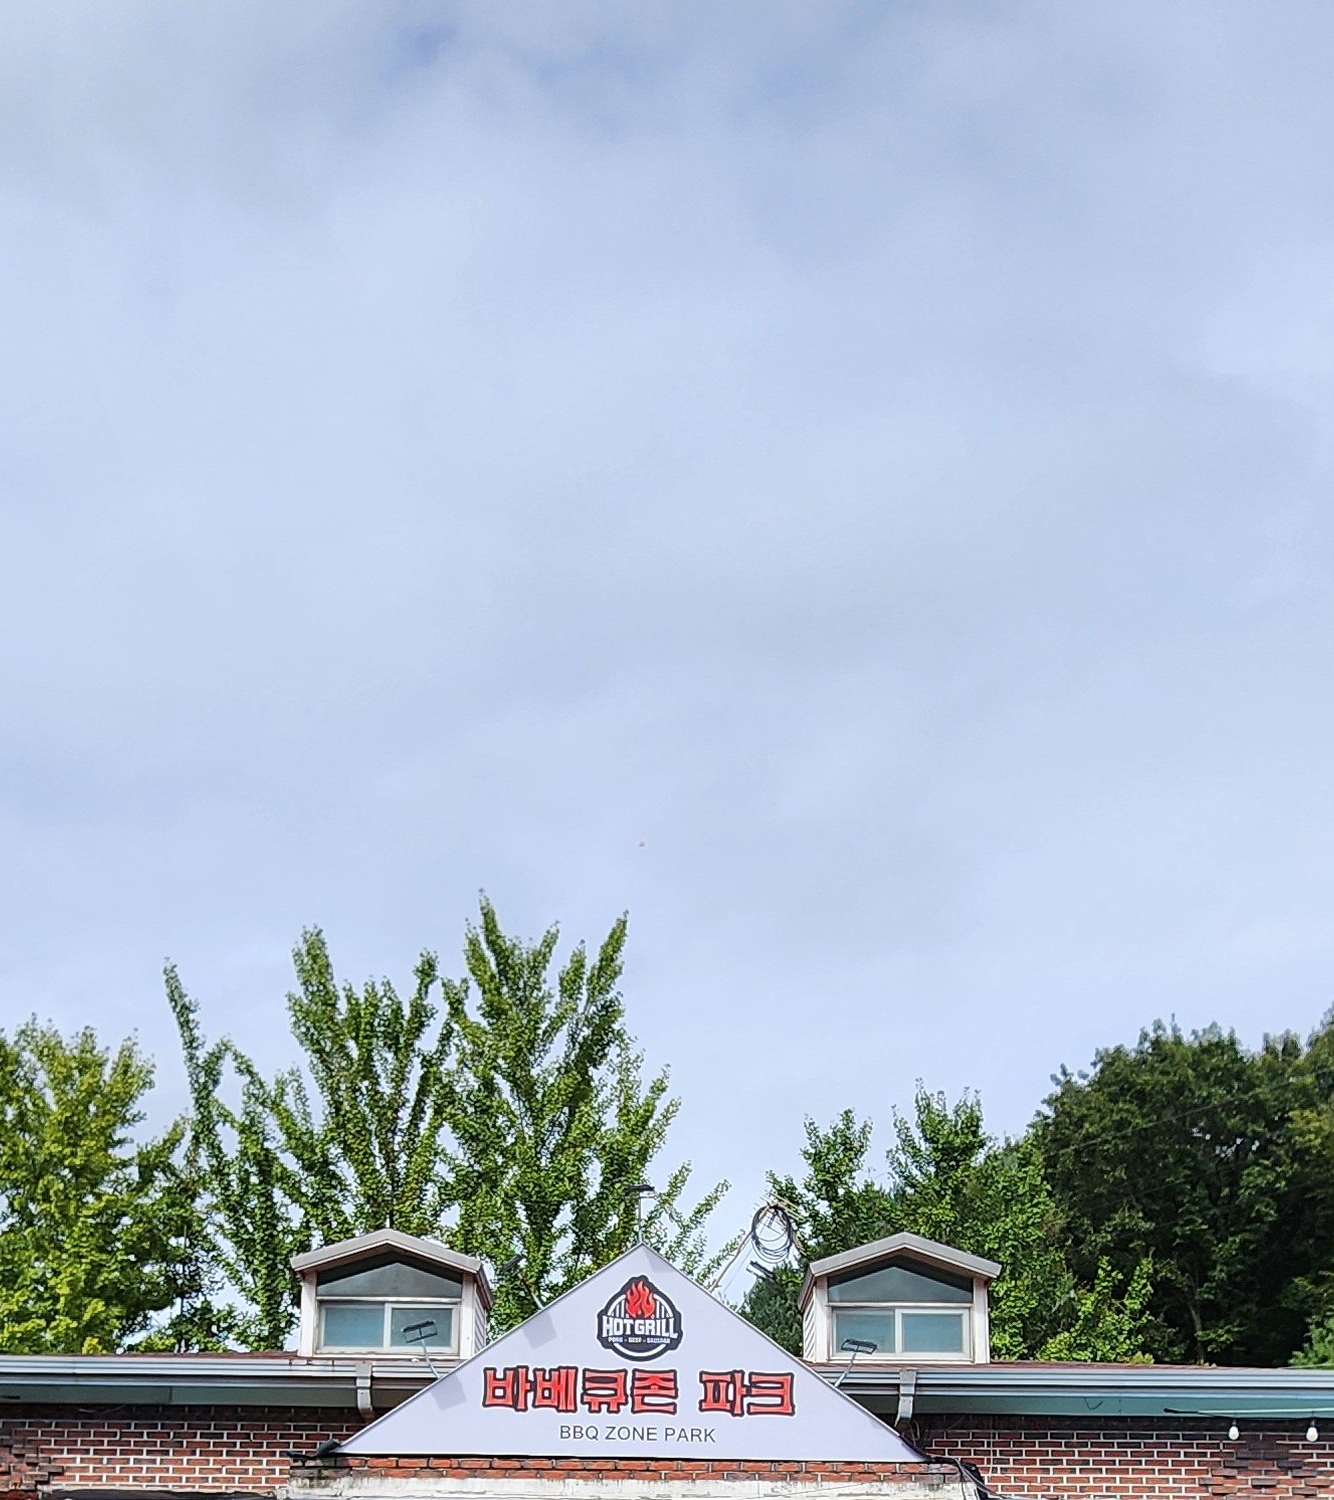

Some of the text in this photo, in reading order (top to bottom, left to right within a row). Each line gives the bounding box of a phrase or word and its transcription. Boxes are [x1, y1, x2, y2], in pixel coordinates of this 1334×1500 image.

[482, 1365, 796, 1417] 바베큐존 파크
[559, 1425, 716, 1443] BBQ ZONE PARK
